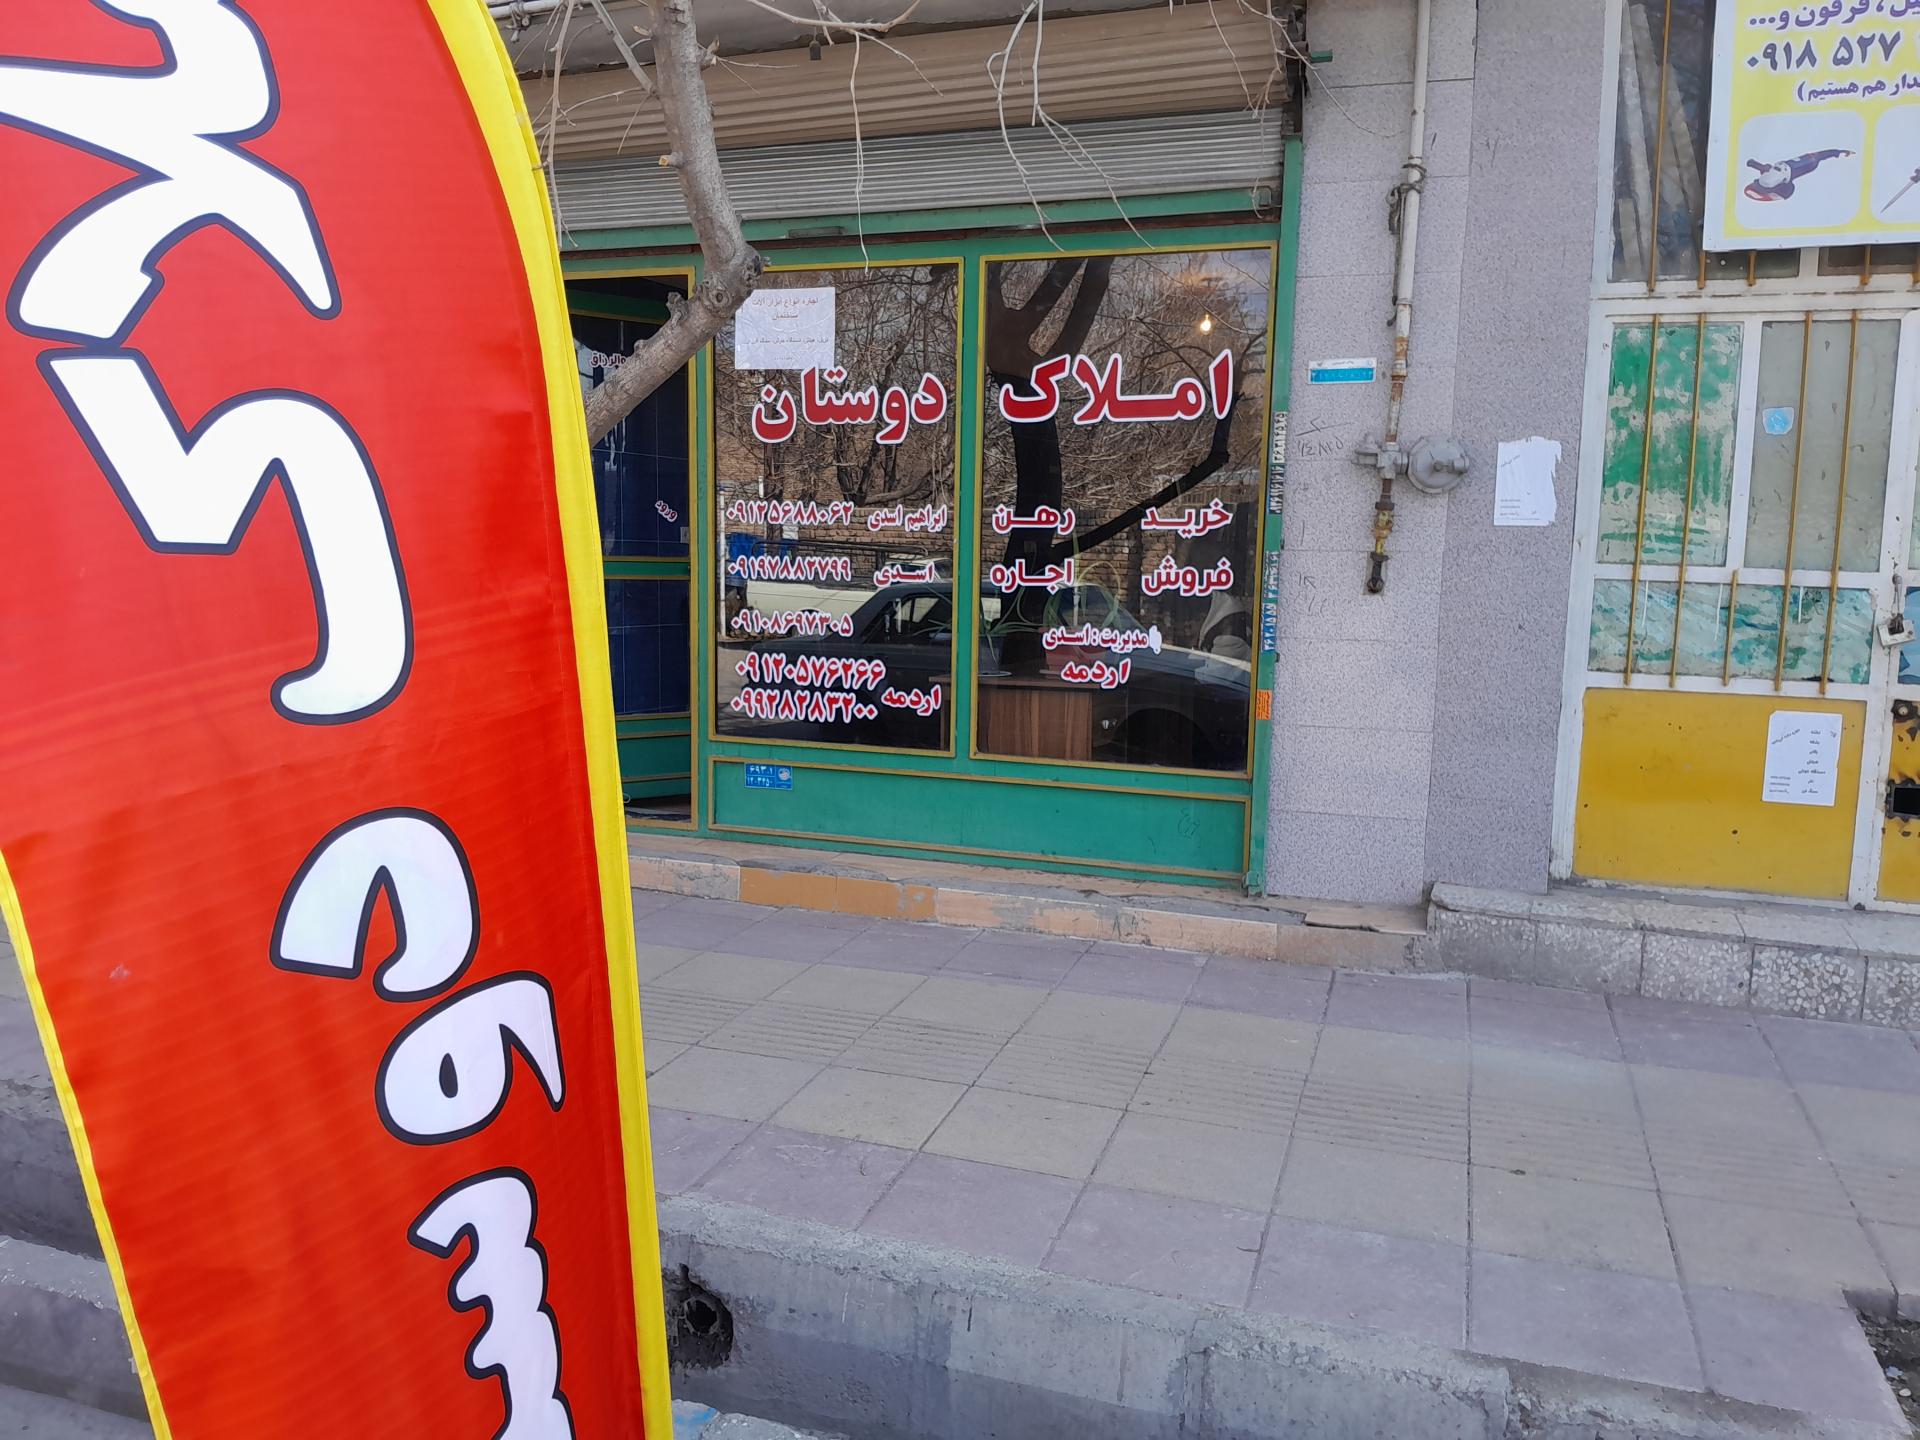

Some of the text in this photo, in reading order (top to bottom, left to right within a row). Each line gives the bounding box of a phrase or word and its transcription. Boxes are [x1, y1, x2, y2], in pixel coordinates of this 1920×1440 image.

[1747, 31, 1901, 71] ۰۹۱۸ ۵۲۷
[1862, 79, 1887, 98] هم
[752, 349, 1234, 444] املاک دوستان
[867, 504, 903, 531] اسدی
[905, 503, 948, 533] ابراهیم
[992, 498, 1234, 539] خرید رهن
[873, 562, 935, 587] اسدی
[990, 558, 1075, 595] اجاره
[1141, 555, 1234, 596] فروش
[1061, 657, 1131, 689] اردمه
[881, 684, 942, 716] اردمه
